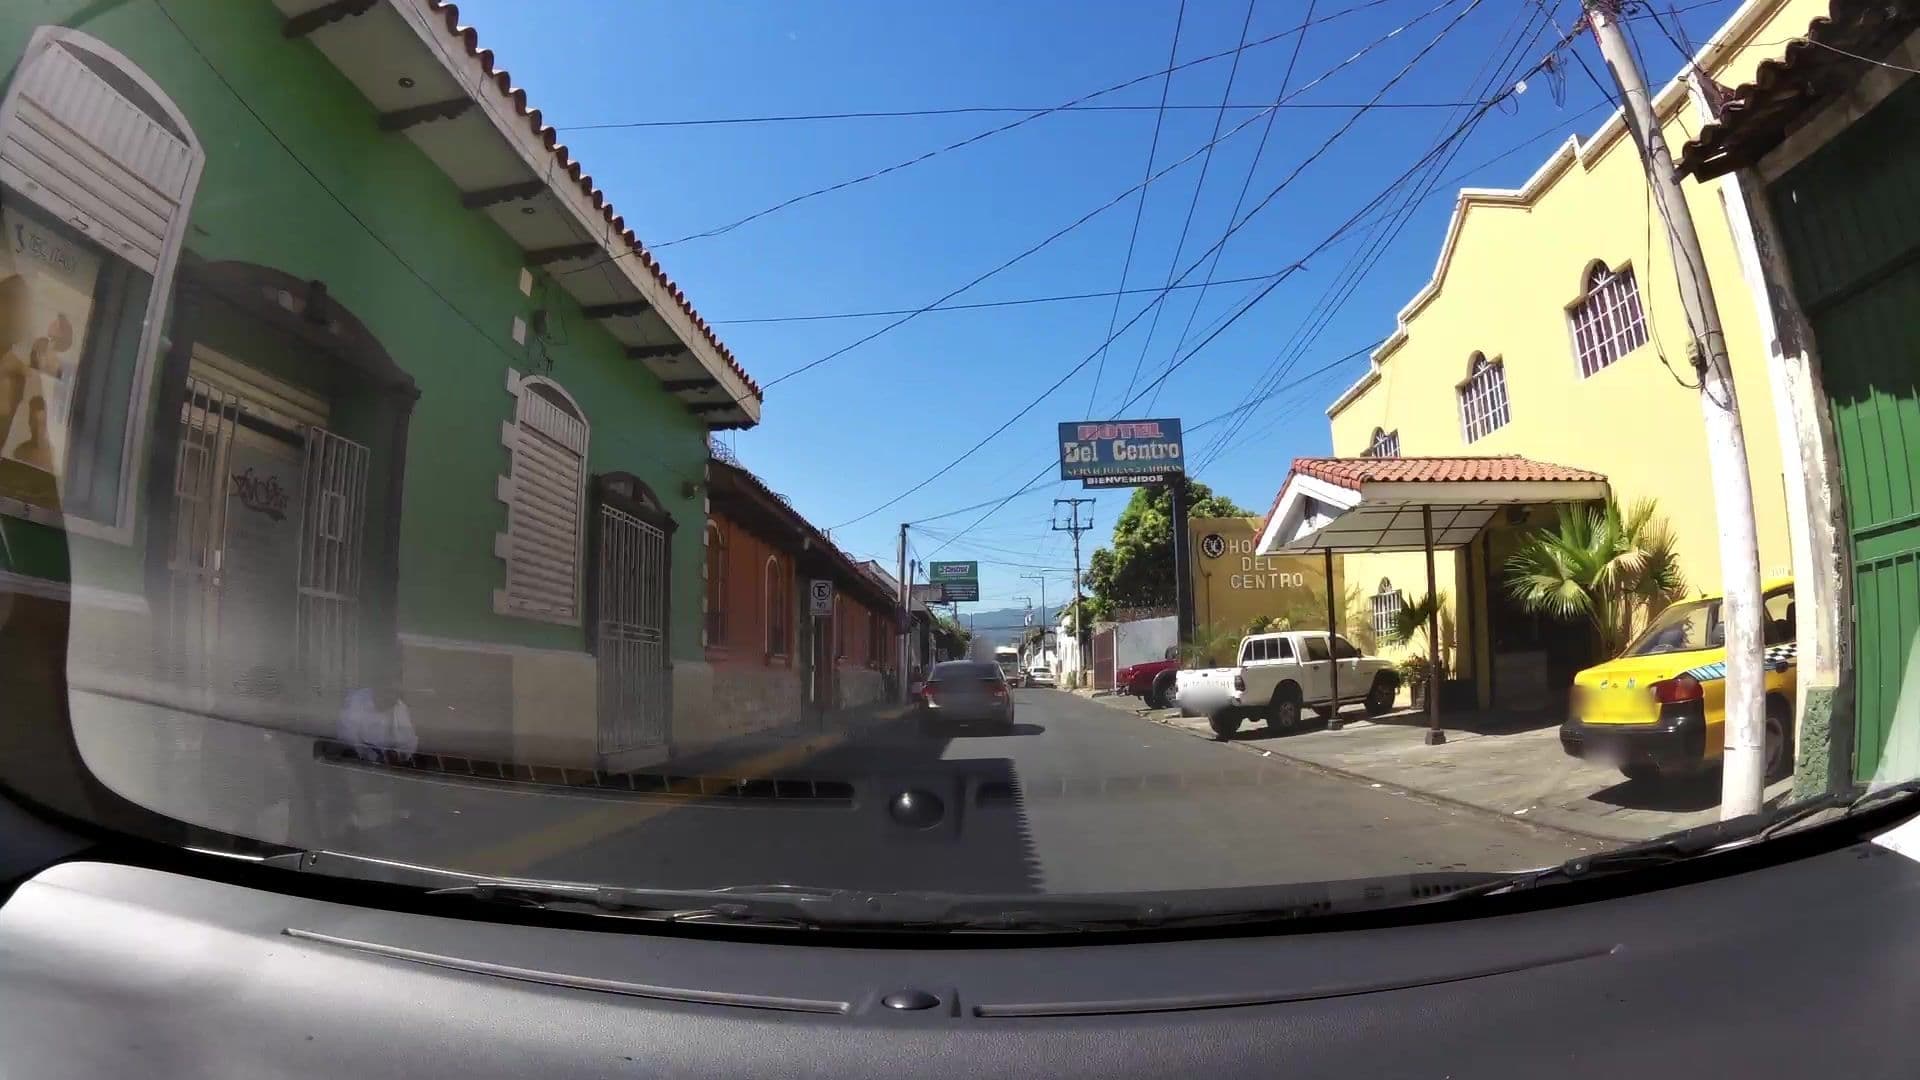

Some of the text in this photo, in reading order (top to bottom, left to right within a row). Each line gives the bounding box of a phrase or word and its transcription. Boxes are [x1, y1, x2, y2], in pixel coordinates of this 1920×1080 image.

[1077, 423, 1163, 440] HOTEL
[1063, 439, 1180, 463] Del Centro
[1086, 474, 1164, 485] BIENVENIDOS
[1242, 556, 1277, 571] DEL
[1230, 572, 1304, 589] CENTRO
